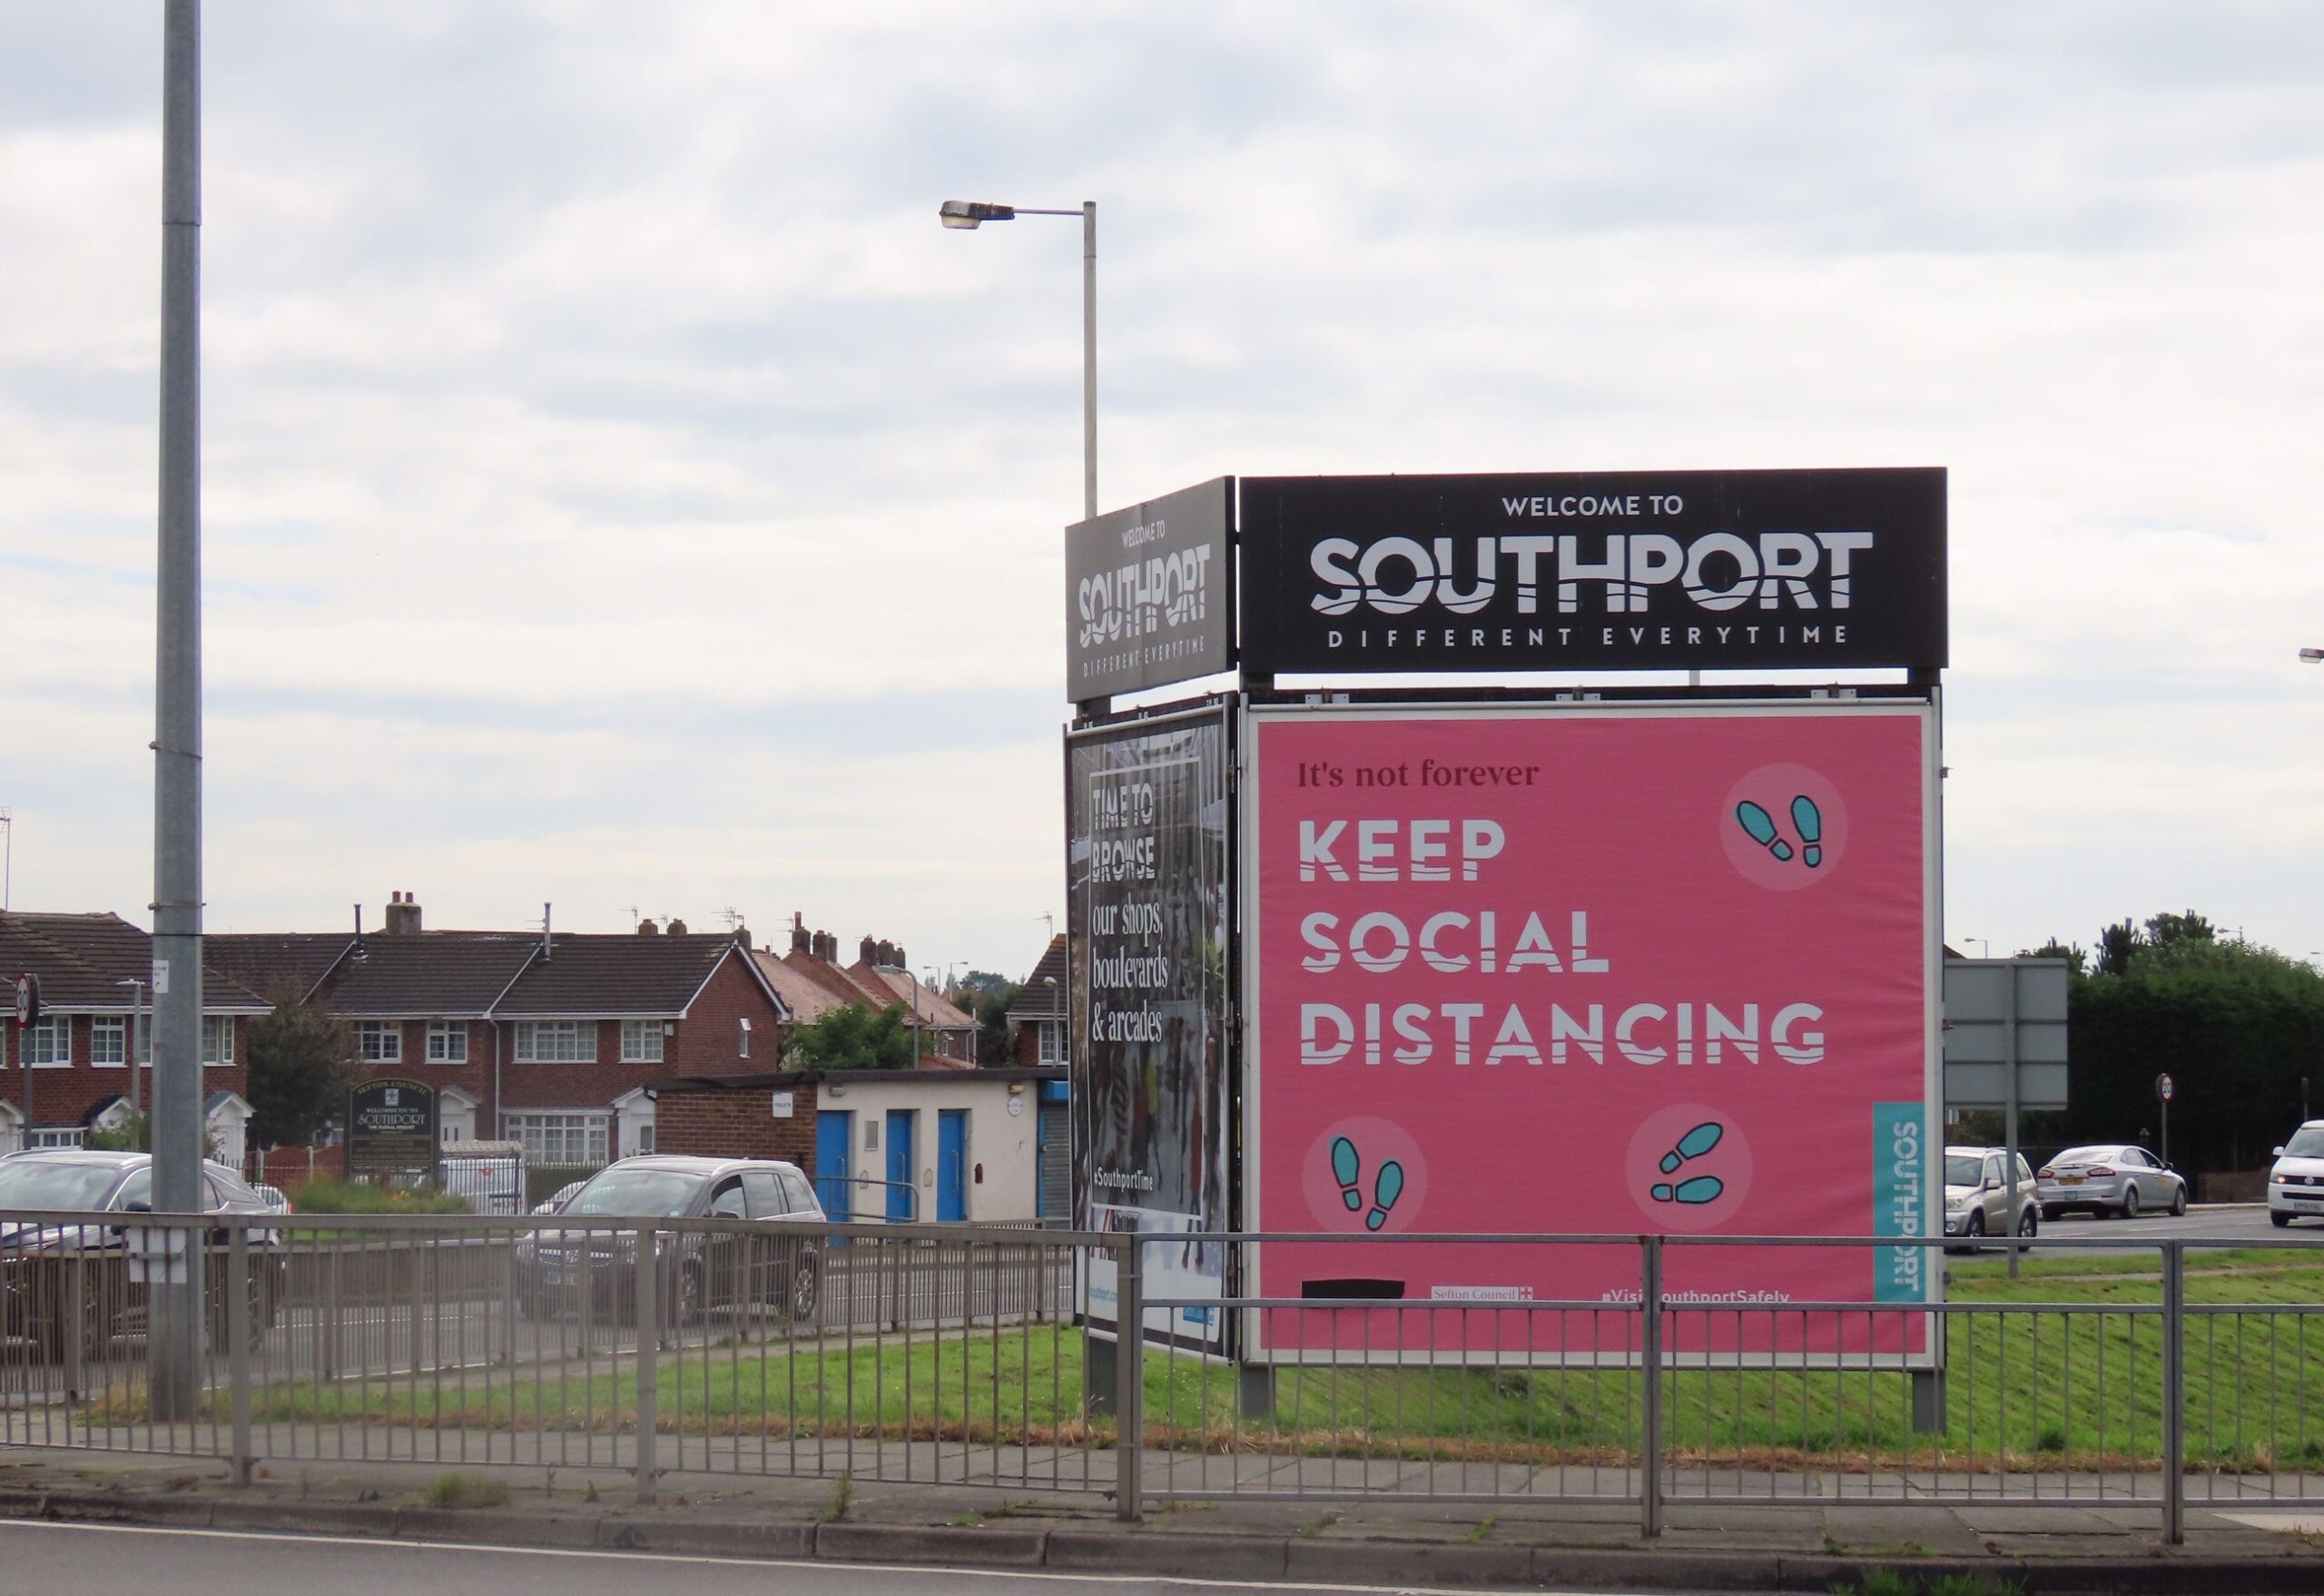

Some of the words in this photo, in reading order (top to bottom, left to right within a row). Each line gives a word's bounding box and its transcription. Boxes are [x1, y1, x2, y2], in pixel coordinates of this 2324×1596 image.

[1502, 495, 1640, 517] WELCOME
[1649, 494, 1684, 516] TO
[1122, 522, 1156, 547] WELCOME
[1157, 519, 1166, 537] TO
[1309, 531, 1874, 616] SOUTHPORT
[1078, 544, 1210, 648] SOUTHPORT
[1083, 649, 1139, 678] DIFFERENT
[1144, 635, 1205, 664] EVERYTIME
[1327, 626, 1573, 648] DIFFERENT
[1602, 625, 1847, 646] EVERYTIME
[1298, 762, 1344, 788] It's
[1355, 762, 1409, 787] not
[1421, 758, 1541, 786] forever
[1092, 785, 1128, 829] TIME
[1132, 783, 1154, 826] TO
[1092, 836, 1156, 883] BROWSE
[1299, 819, 1506, 882] KEEP
[1092, 904, 1118, 936] our
[1121, 892, 1164, 947] shops,
[1300, 911, 1610, 974] SOCIAL
[1092, 944, 1168, 989] boulevards
[1092, 1000, 1105, 1042] &
[1108, 1000, 1162, 1043] arcades
[1300, 1002, 1825, 1065] DISTANCING
[357, 1114, 426, 1126] SOUTHPORT
[1094, 1166, 1153, 1193] #SouthportTime
[1434, 1288, 1469, 1300] Sefton
[1472, 1288, 1515, 1300] Council
[1601, 1288, 1790, 1302] #VisiouthportSafely
